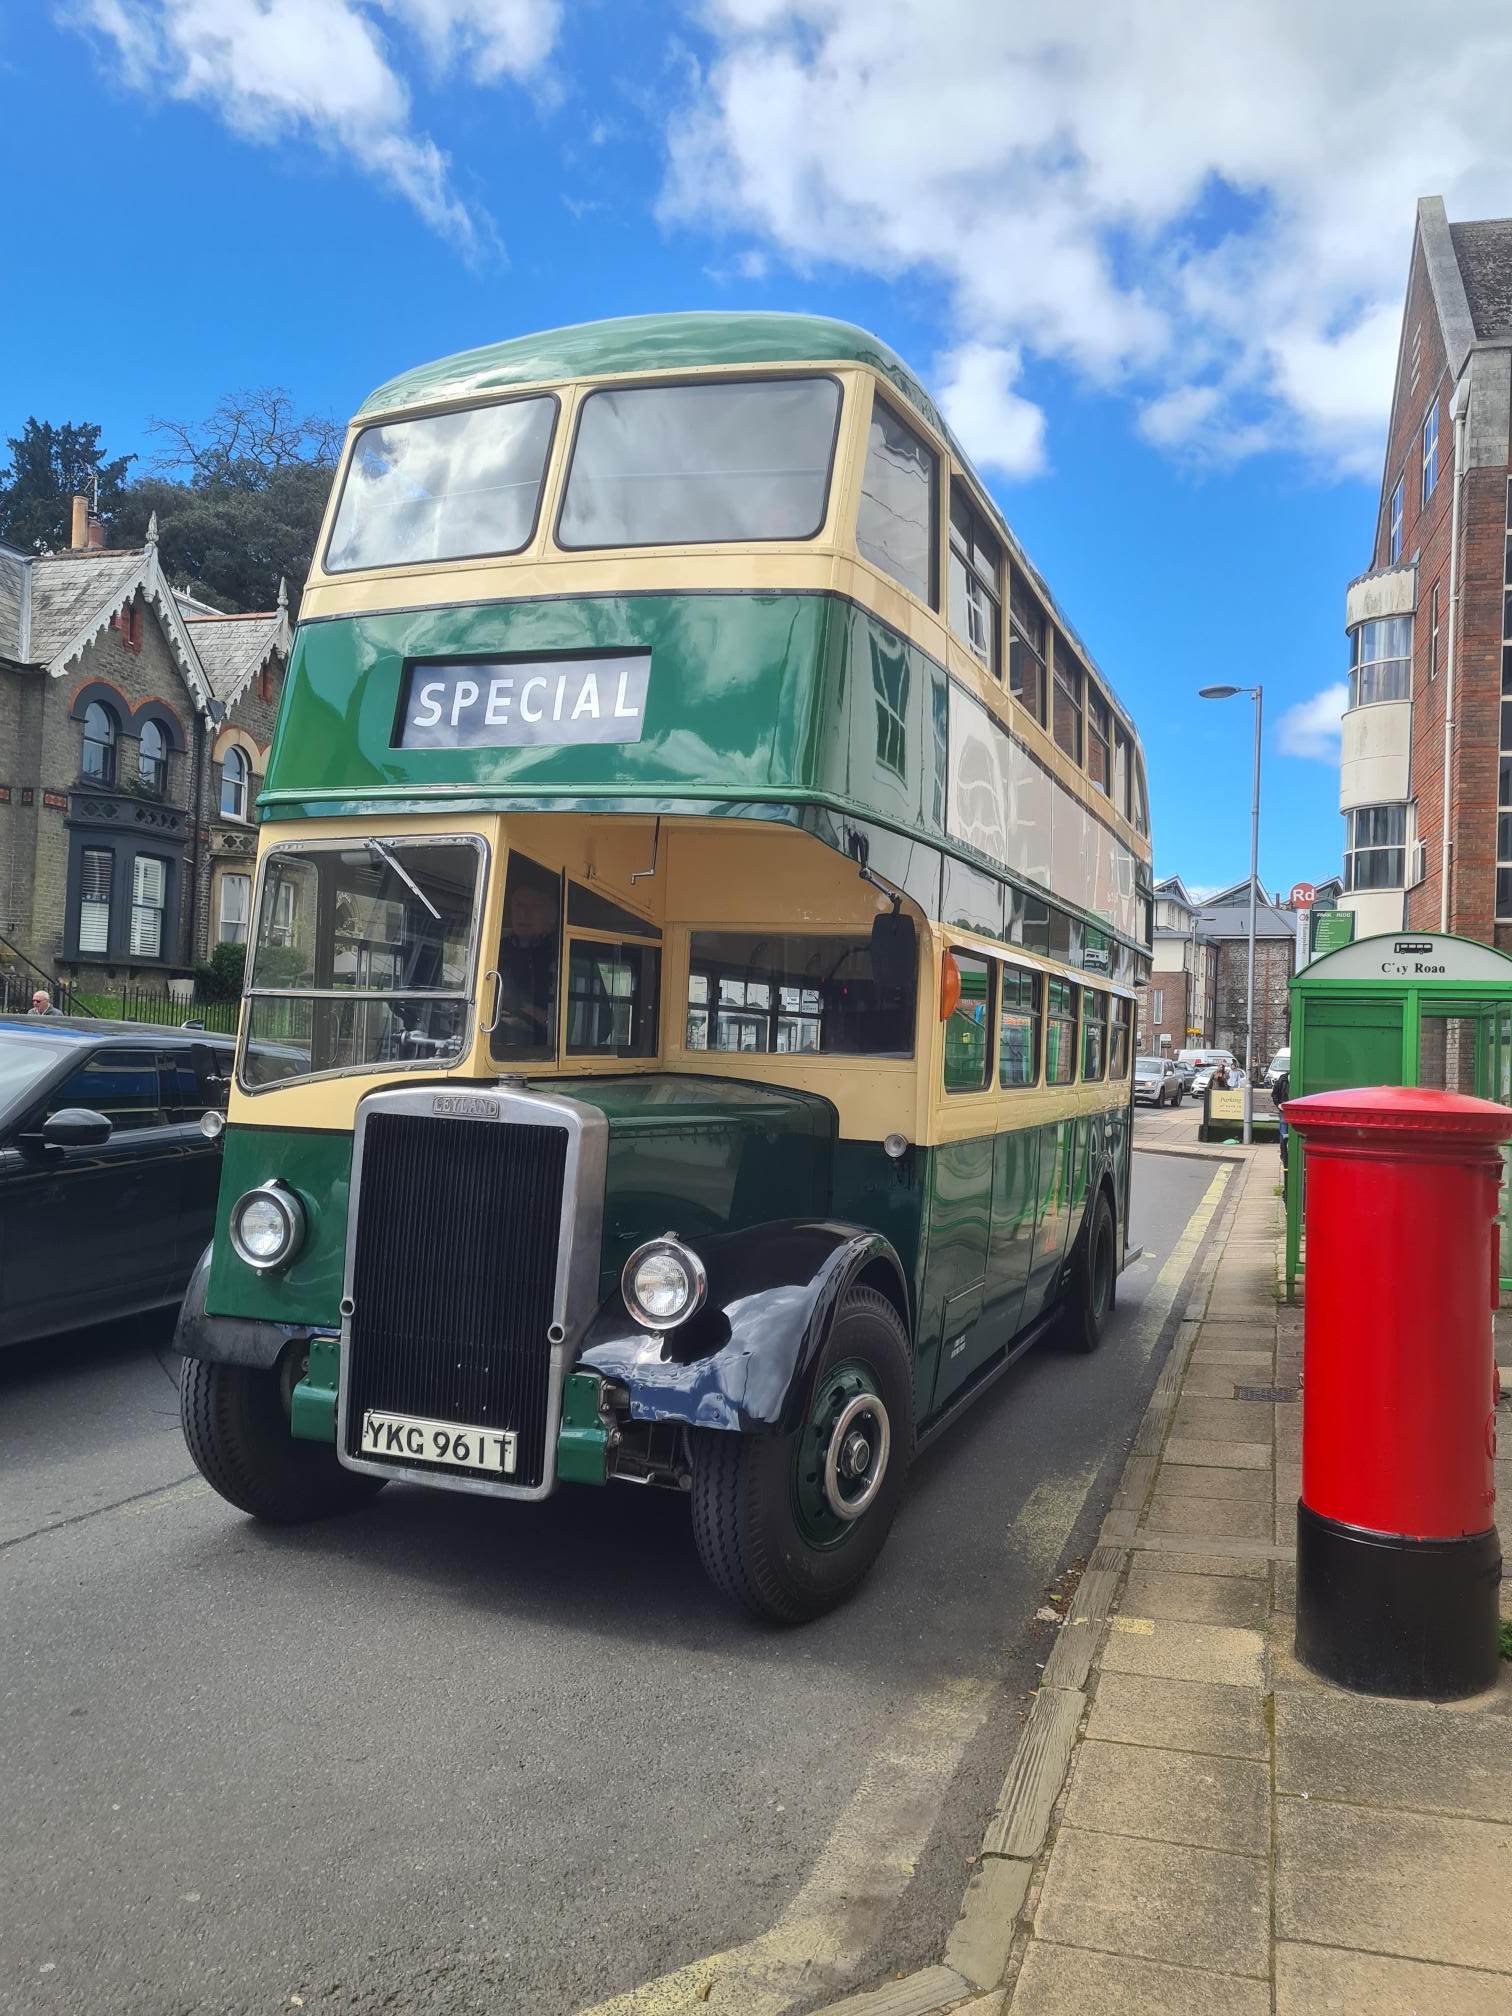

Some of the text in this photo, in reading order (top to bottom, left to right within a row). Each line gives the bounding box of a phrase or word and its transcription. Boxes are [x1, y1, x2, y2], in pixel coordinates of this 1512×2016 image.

[413, 671, 639, 727] SPECIAL
[1292, 888, 1315, 902] Rd
[434, 1098, 497, 1115] LEYLAND
